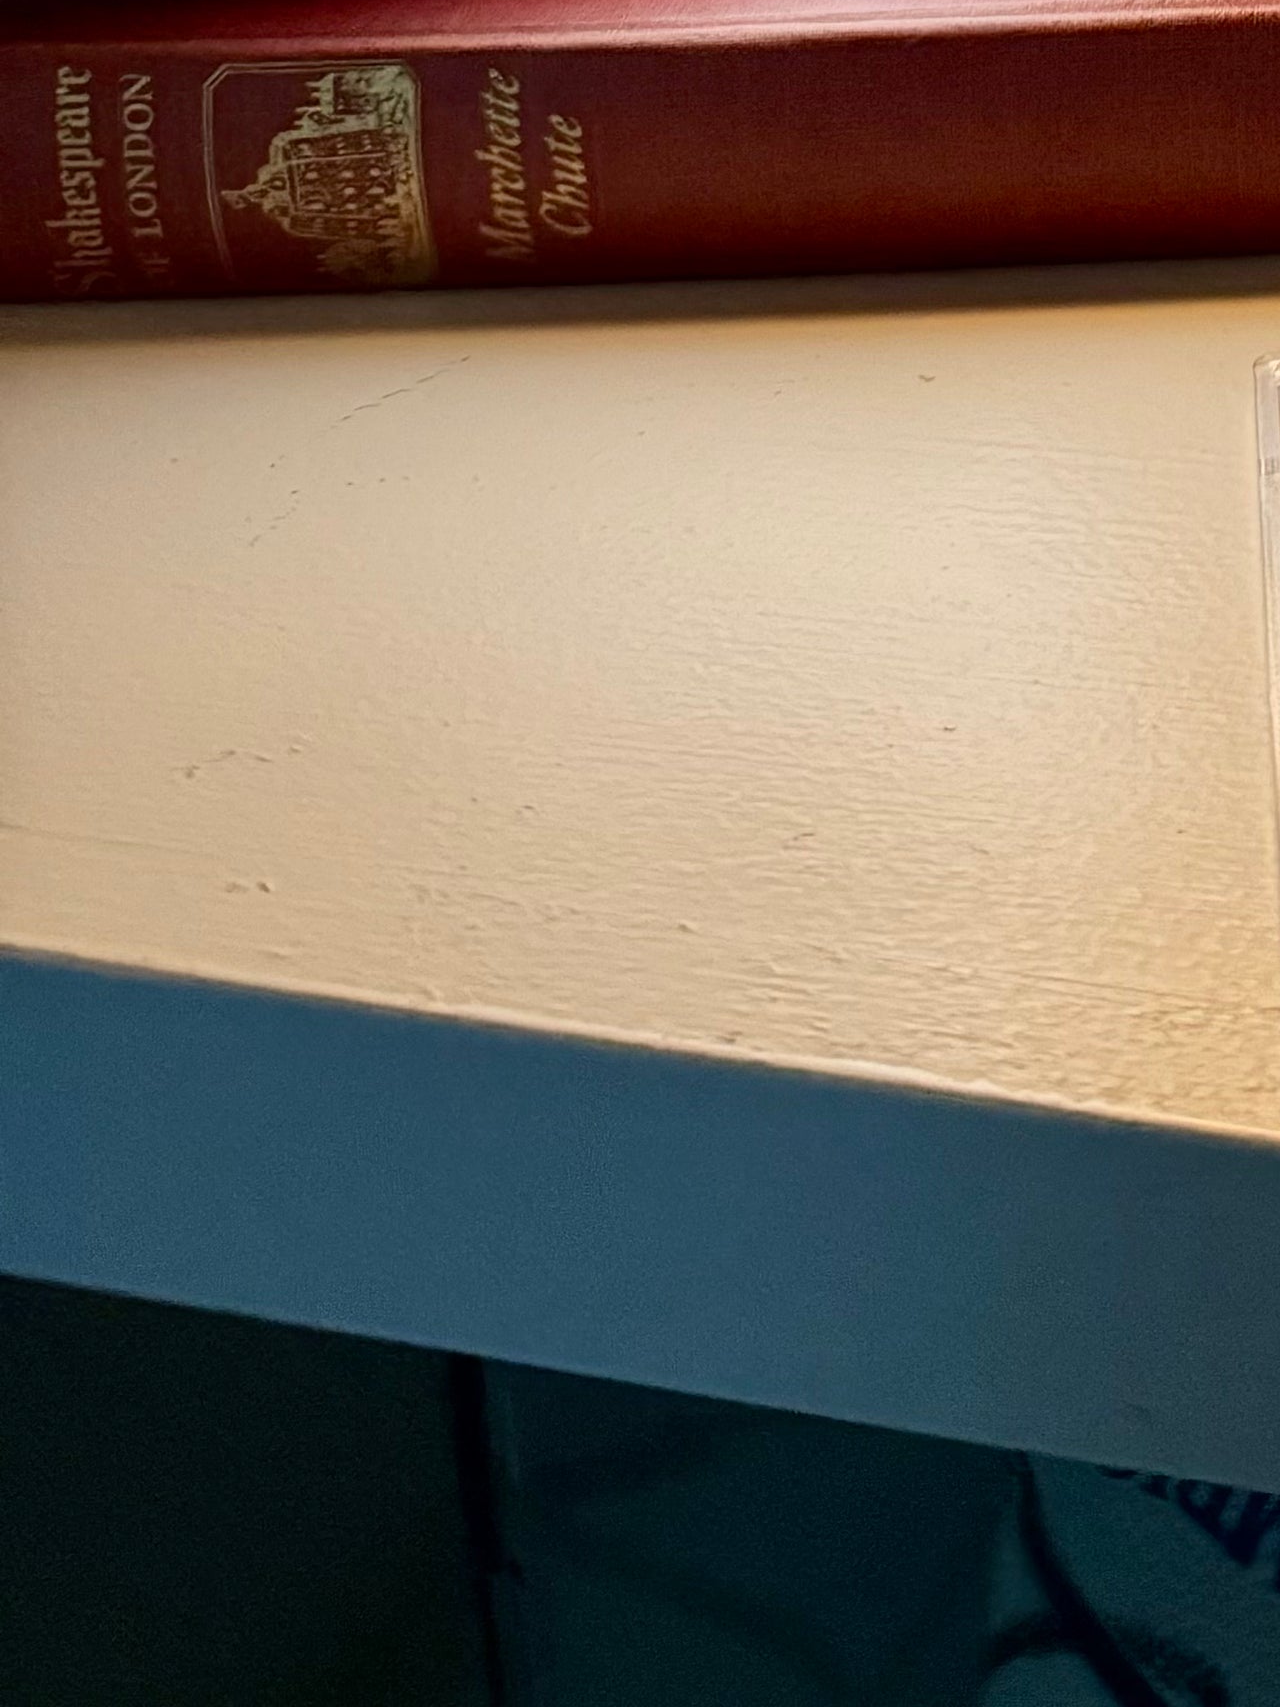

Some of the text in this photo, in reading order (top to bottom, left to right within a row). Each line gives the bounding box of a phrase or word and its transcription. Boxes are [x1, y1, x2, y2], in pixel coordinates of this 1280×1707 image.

[44, 65, 117, 294] Shakespeare
[119, 73, 164, 240] LONDON
[474, 68, 536, 263] Marchette
[537, 113, 594, 238] Chute
